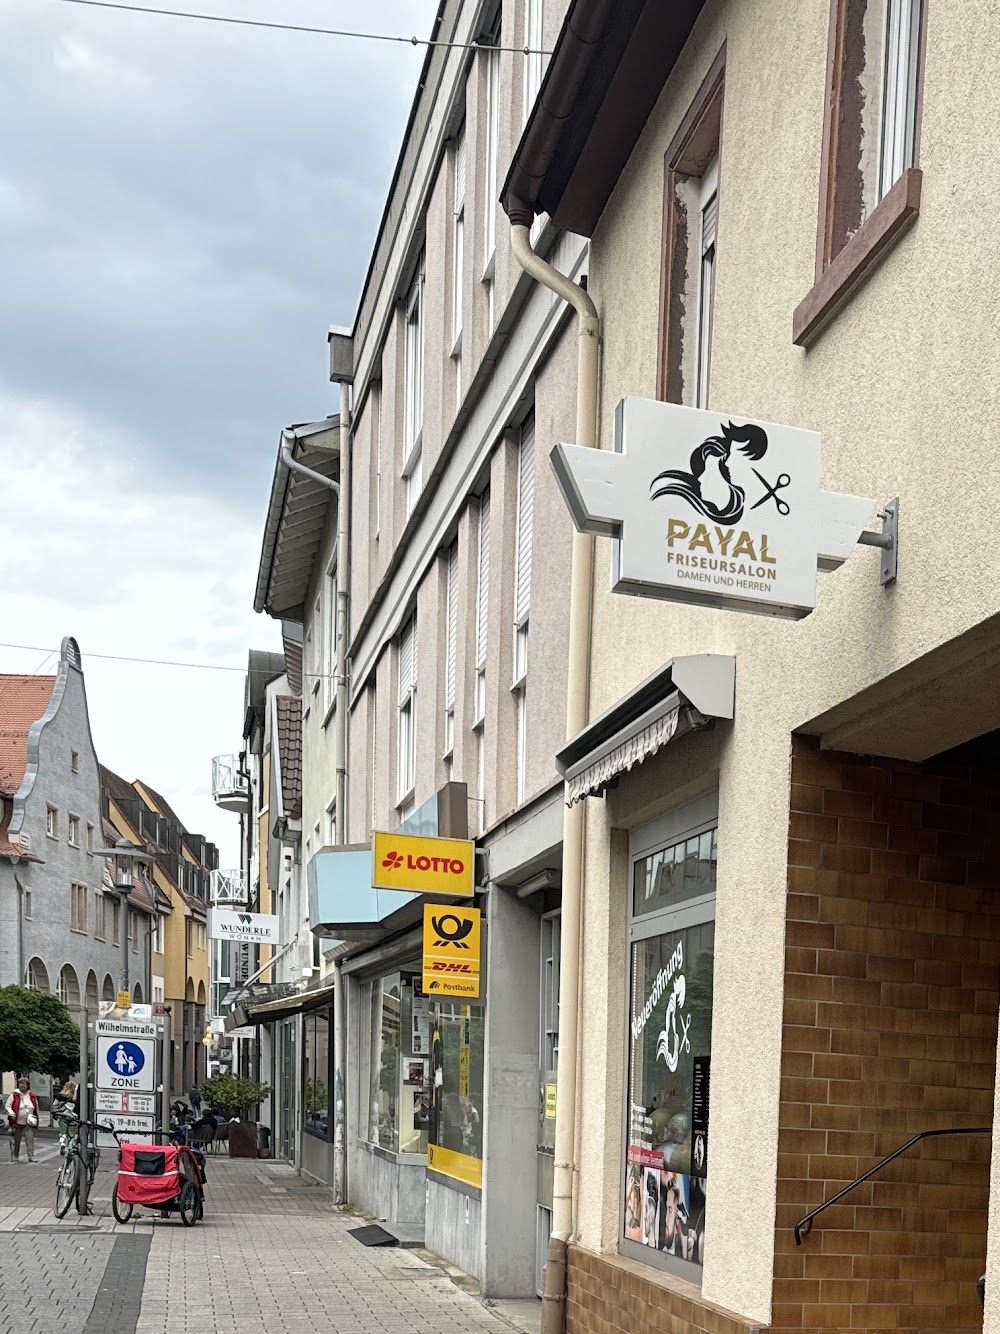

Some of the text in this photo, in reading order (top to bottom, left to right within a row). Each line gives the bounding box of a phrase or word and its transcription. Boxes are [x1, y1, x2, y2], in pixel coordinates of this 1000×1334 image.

[666, 518, 776, 564] PAYAL
[667, 552, 776, 580] FRISEURSALON
[677, 569, 771, 592] DAMEN UND HERREN
[407, 854, 464, 875] LOTTO
[220, 924, 271, 935] WUNDERLE
[241, 943, 249, 982] WUNDE
[431, 962, 472, 974] DHL
[443, 983, 475, 992] Postbank
[631, 939, 683, 1040] Neueröffnung
[98, 1022, 154, 1034] Wilhelmstraße
[111, 1077, 140, 1088] ZONE
